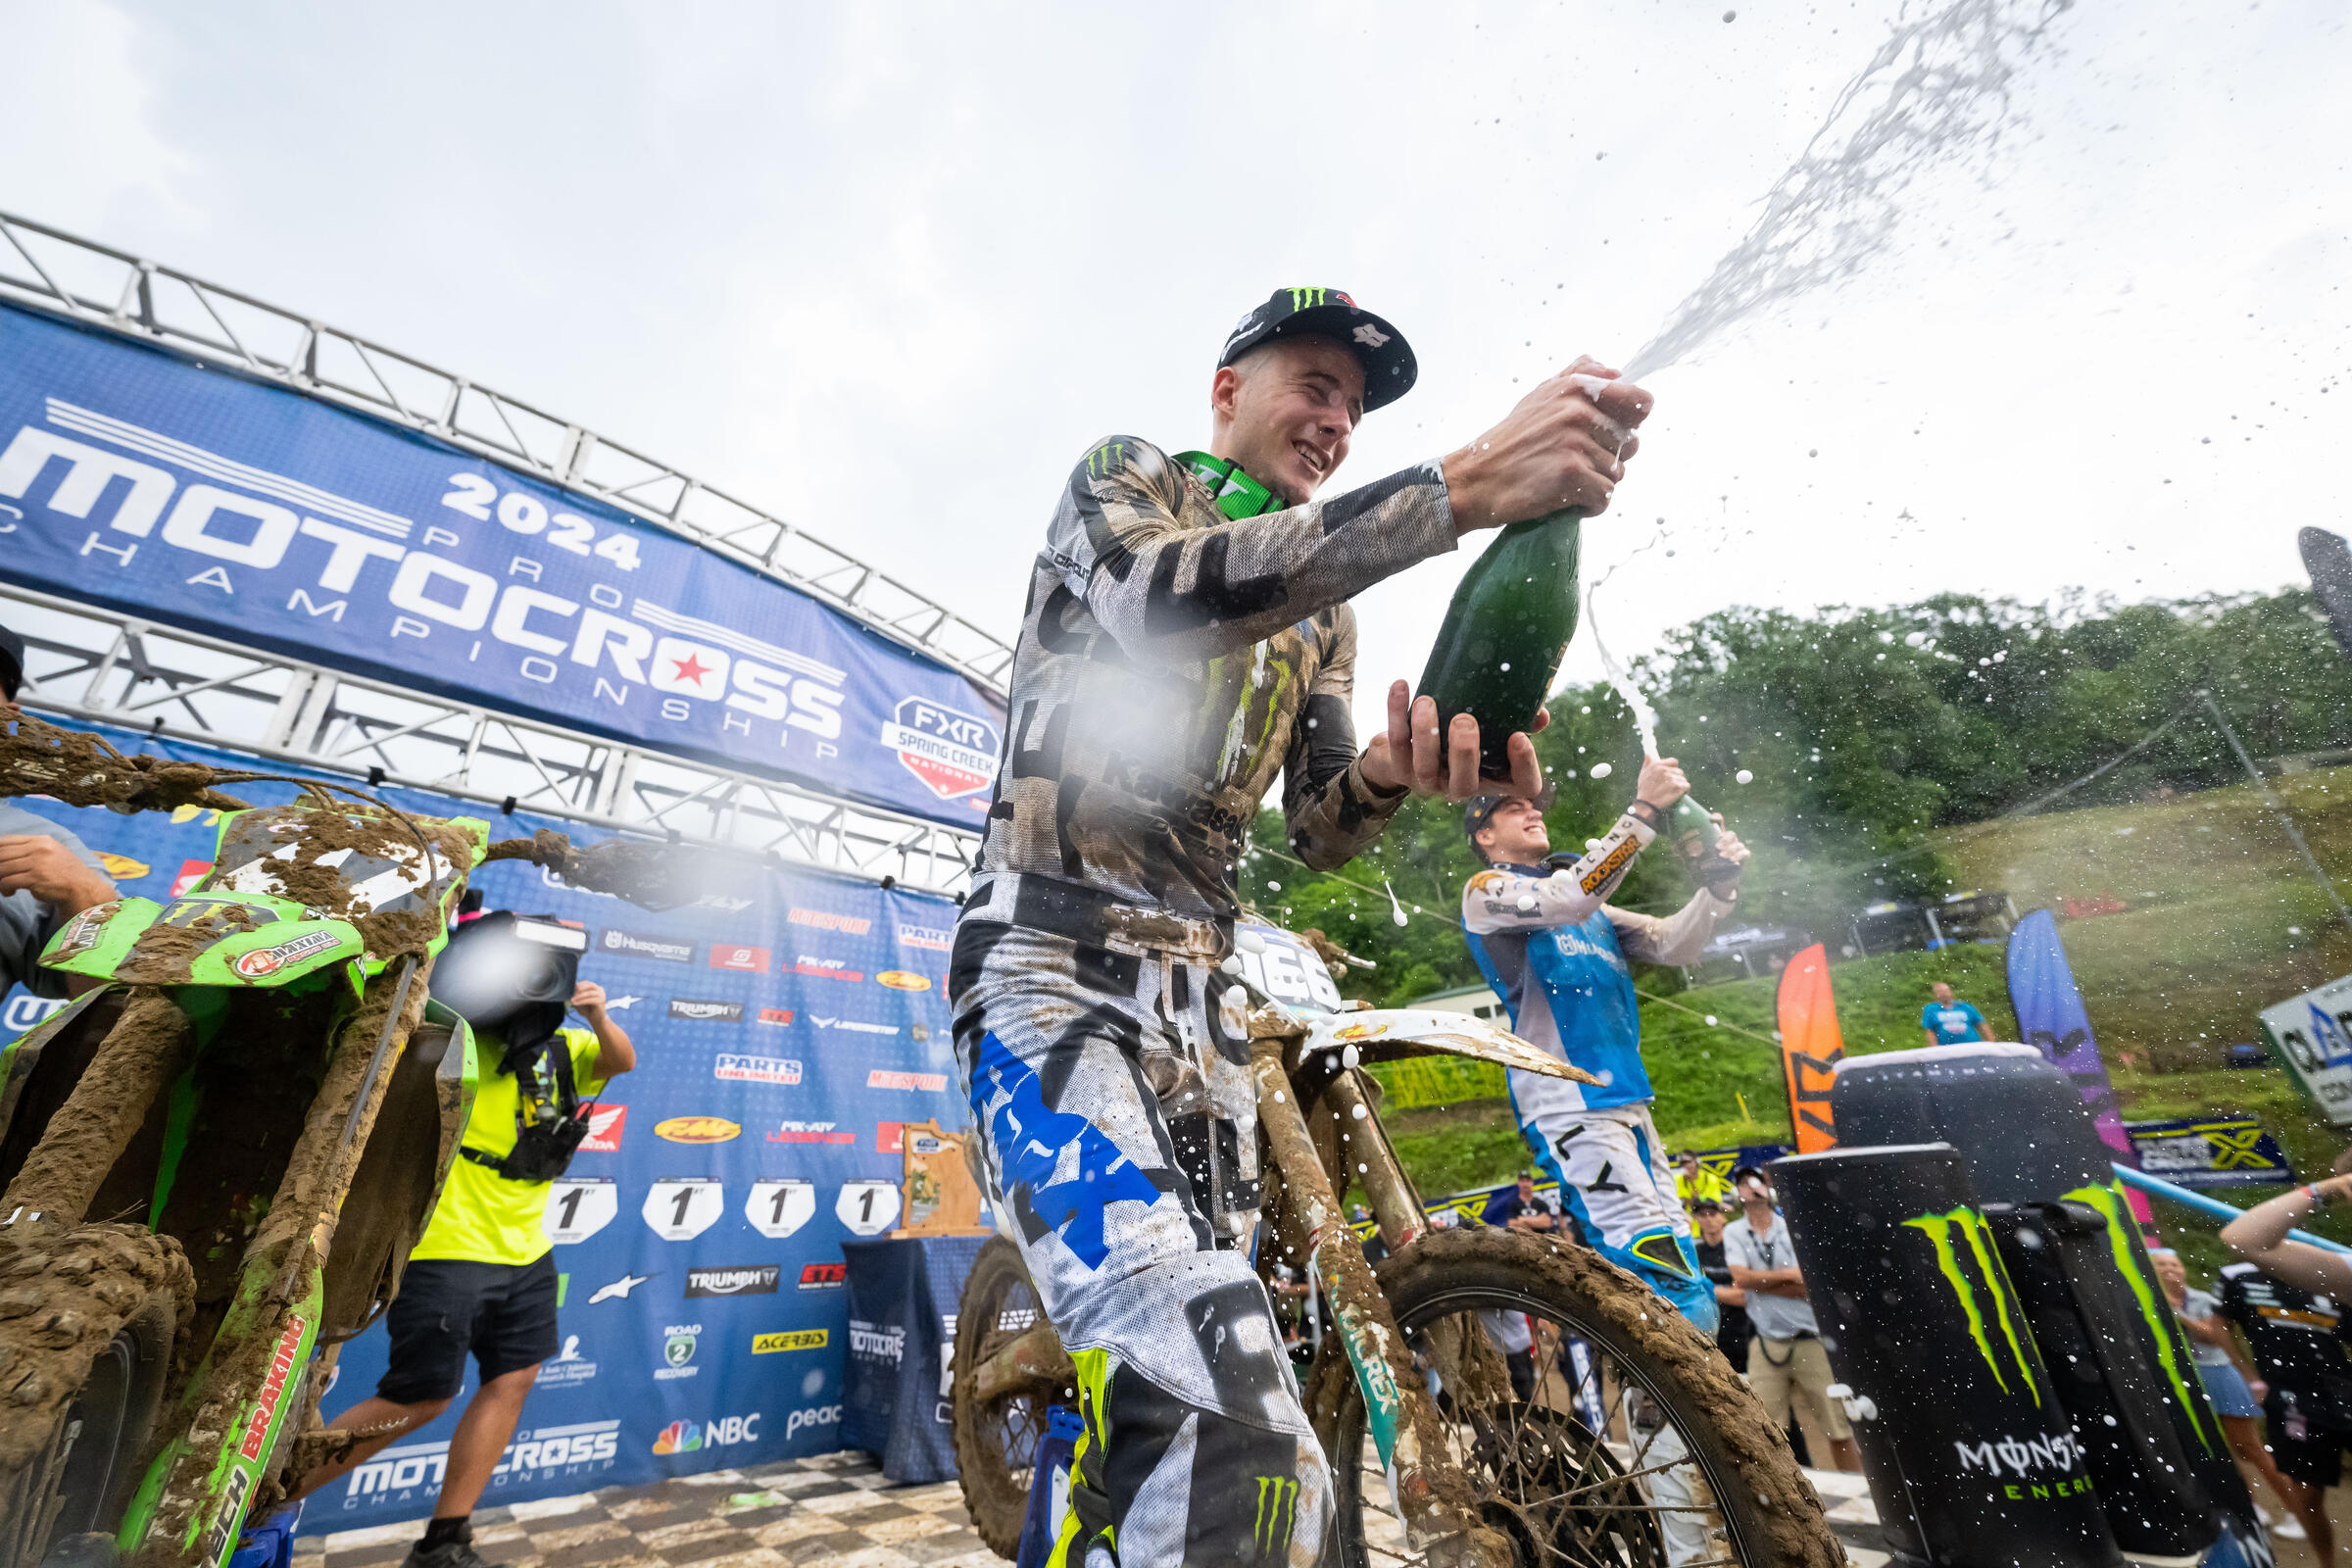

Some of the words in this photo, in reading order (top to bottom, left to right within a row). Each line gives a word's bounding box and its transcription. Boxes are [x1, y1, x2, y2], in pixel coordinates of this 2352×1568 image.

[442, 472, 642, 571] 2024
[0, 425, 846, 740] MOTOCROSS
[422, 526, 623, 610] PRO
[914, 705, 985, 749] FXR
[898, 731, 949, 760] SPRING
[952, 749, 994, 774] CREEK
[908, 757, 981, 784] NATIONAL
[1575, 820, 1633, 877] ACING
[1580, 834, 1642, 896] ROCKSTAR
[901, 925, 951, 943] PART
[671, 1001, 729, 1018] TRIUMPH
[718, 1057, 800, 1074] PARTS
[689, 1269, 761, 1294] TRIUMPH
[663, 1324, 703, 1338] ROAD
[756, 1332, 825, 1350] ACERBIS
[672, 1345, 686, 1361] 2
[239, 1314, 307, 1464] BRAKING
[705, 1412, 760, 1448] NBC
[786, 1404, 843, 1441] peac
[347, 1431, 619, 1497] MOTCROSS
[1953, 1432, 2082, 1479] MONST
[343, 1459, 614, 1510] CHAMONSHIP
[201, 1467, 249, 1568] ECH
